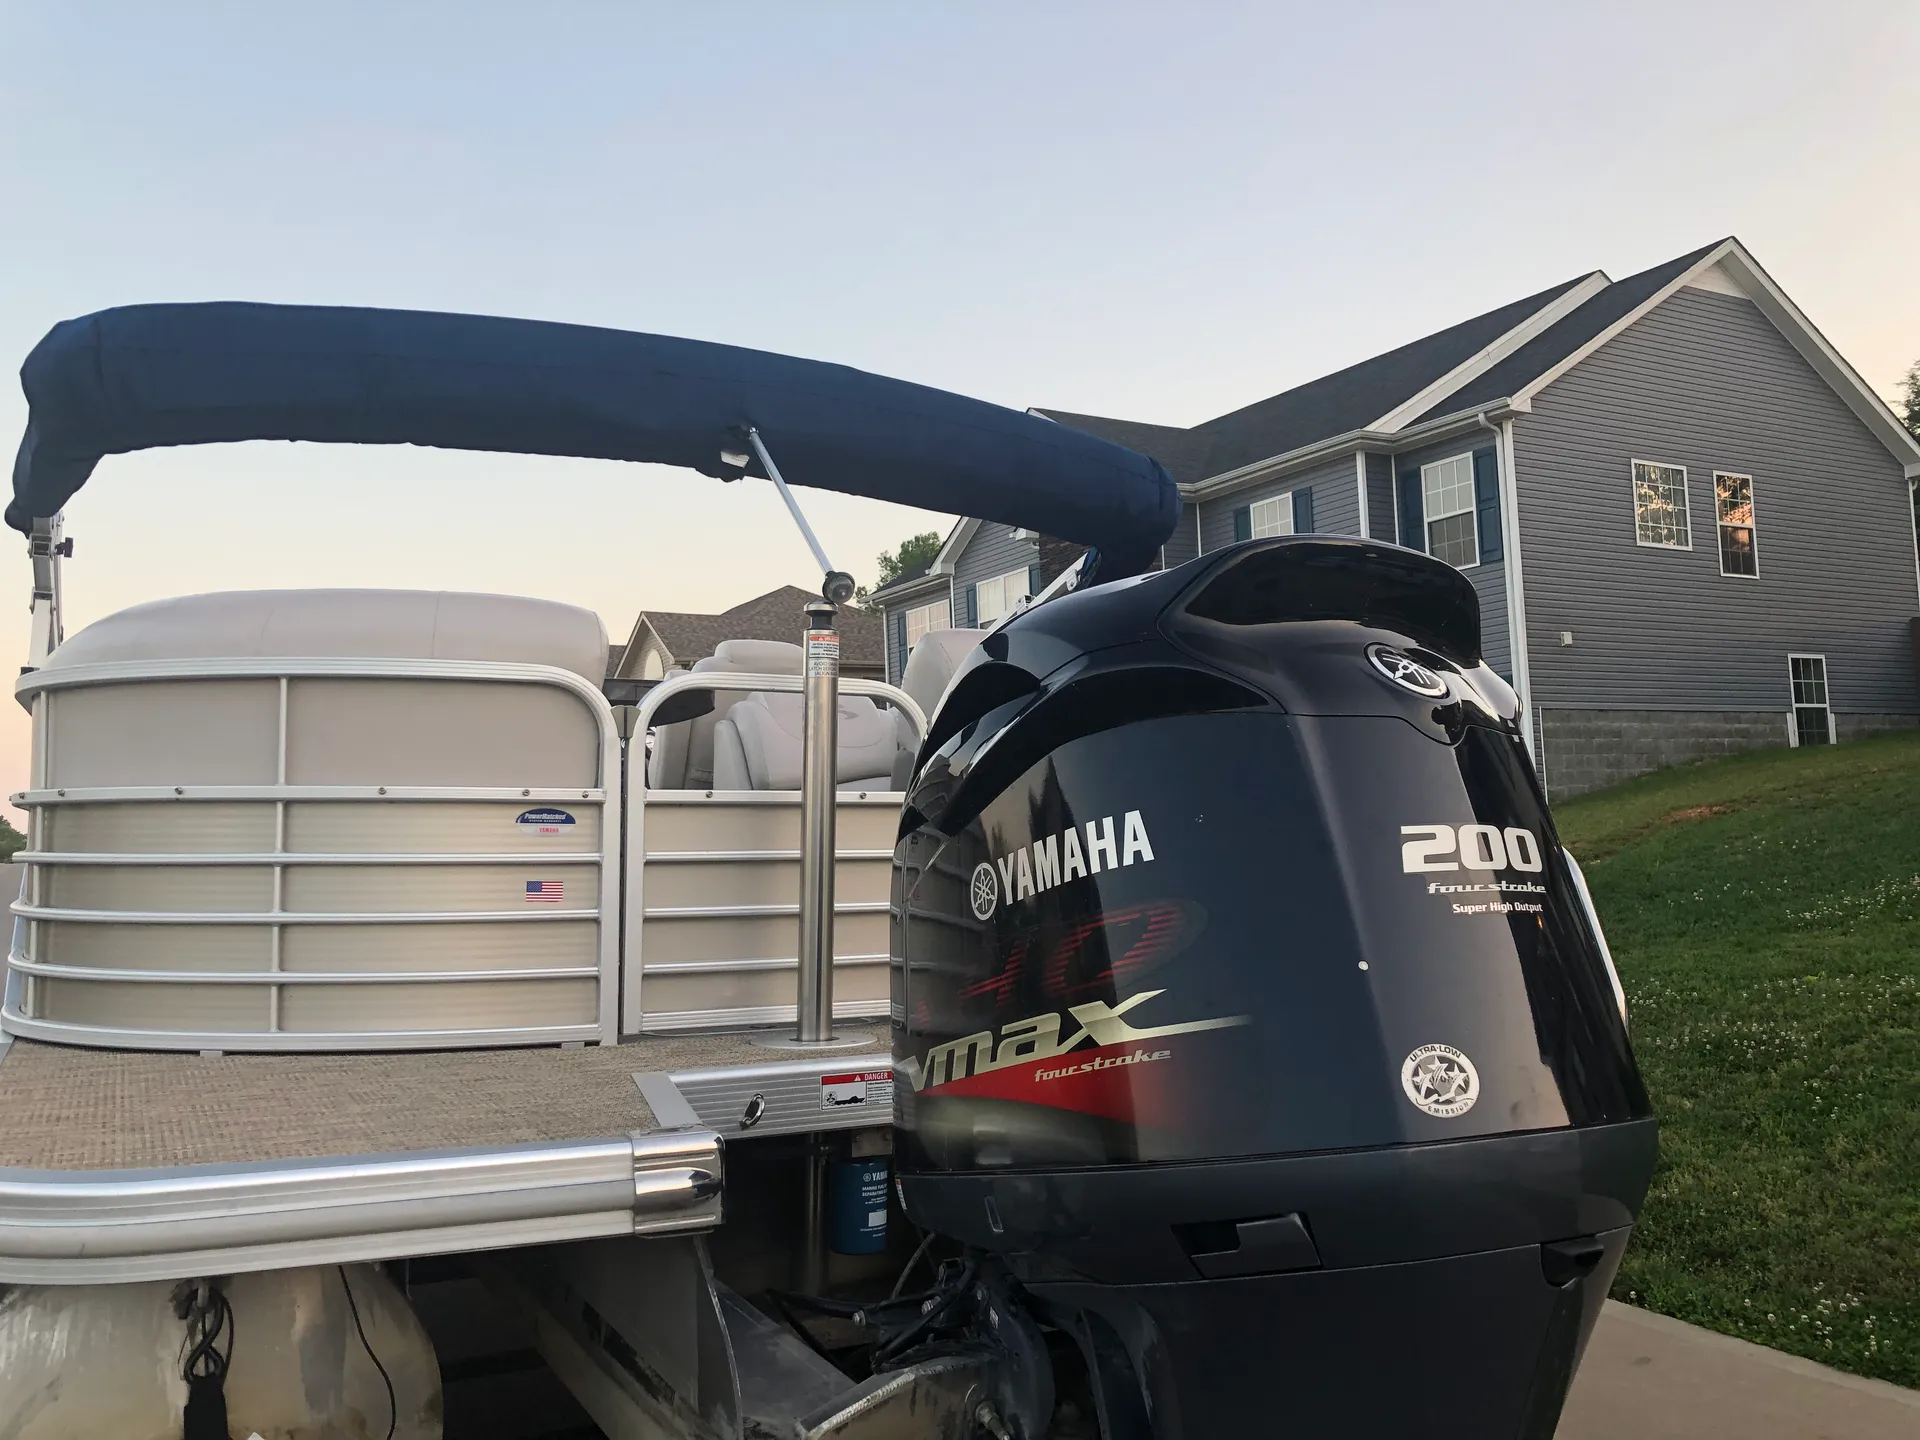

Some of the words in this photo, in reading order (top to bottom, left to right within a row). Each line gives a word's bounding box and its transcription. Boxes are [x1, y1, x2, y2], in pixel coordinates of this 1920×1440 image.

[1400, 824, 1543, 873] 200
[997, 809, 1155, 906] YAMAHA
[1452, 903, 1487, 915] Super
[1490, 901, 1513, 914] High
[1515, 902, 1543, 913] Output
[864, 1072, 888, 1081] DANGER
[1427, 1101, 1470, 1115] EMISSION
